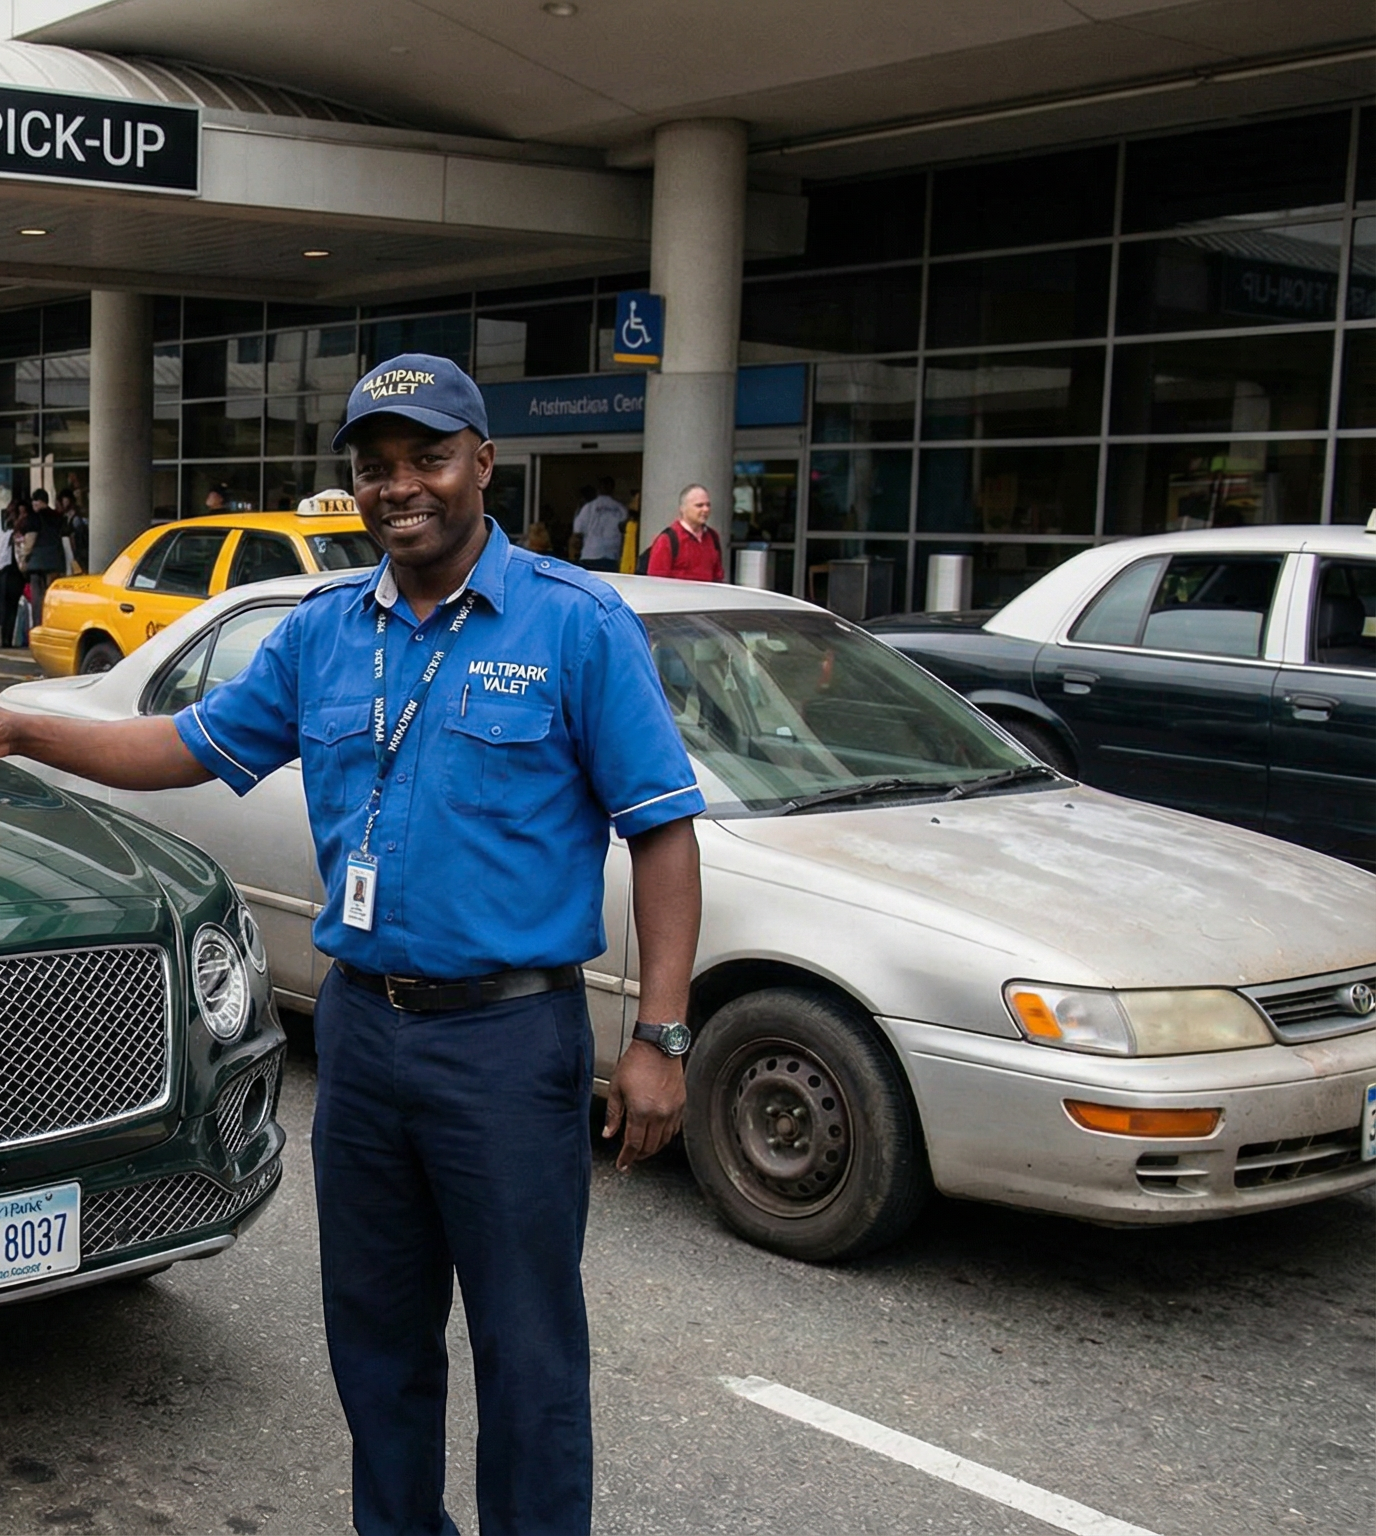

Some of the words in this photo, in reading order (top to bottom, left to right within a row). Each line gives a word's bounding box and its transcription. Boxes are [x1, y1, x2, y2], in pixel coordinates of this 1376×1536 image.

[362, 369, 435, 392] MULTIPARK
[370, 382, 419, 400] VALET
[468, 660, 549, 682] MULTIPARK
[483, 676, 530, 695] VALET
[4, 1212, 67, 1263] 8037
